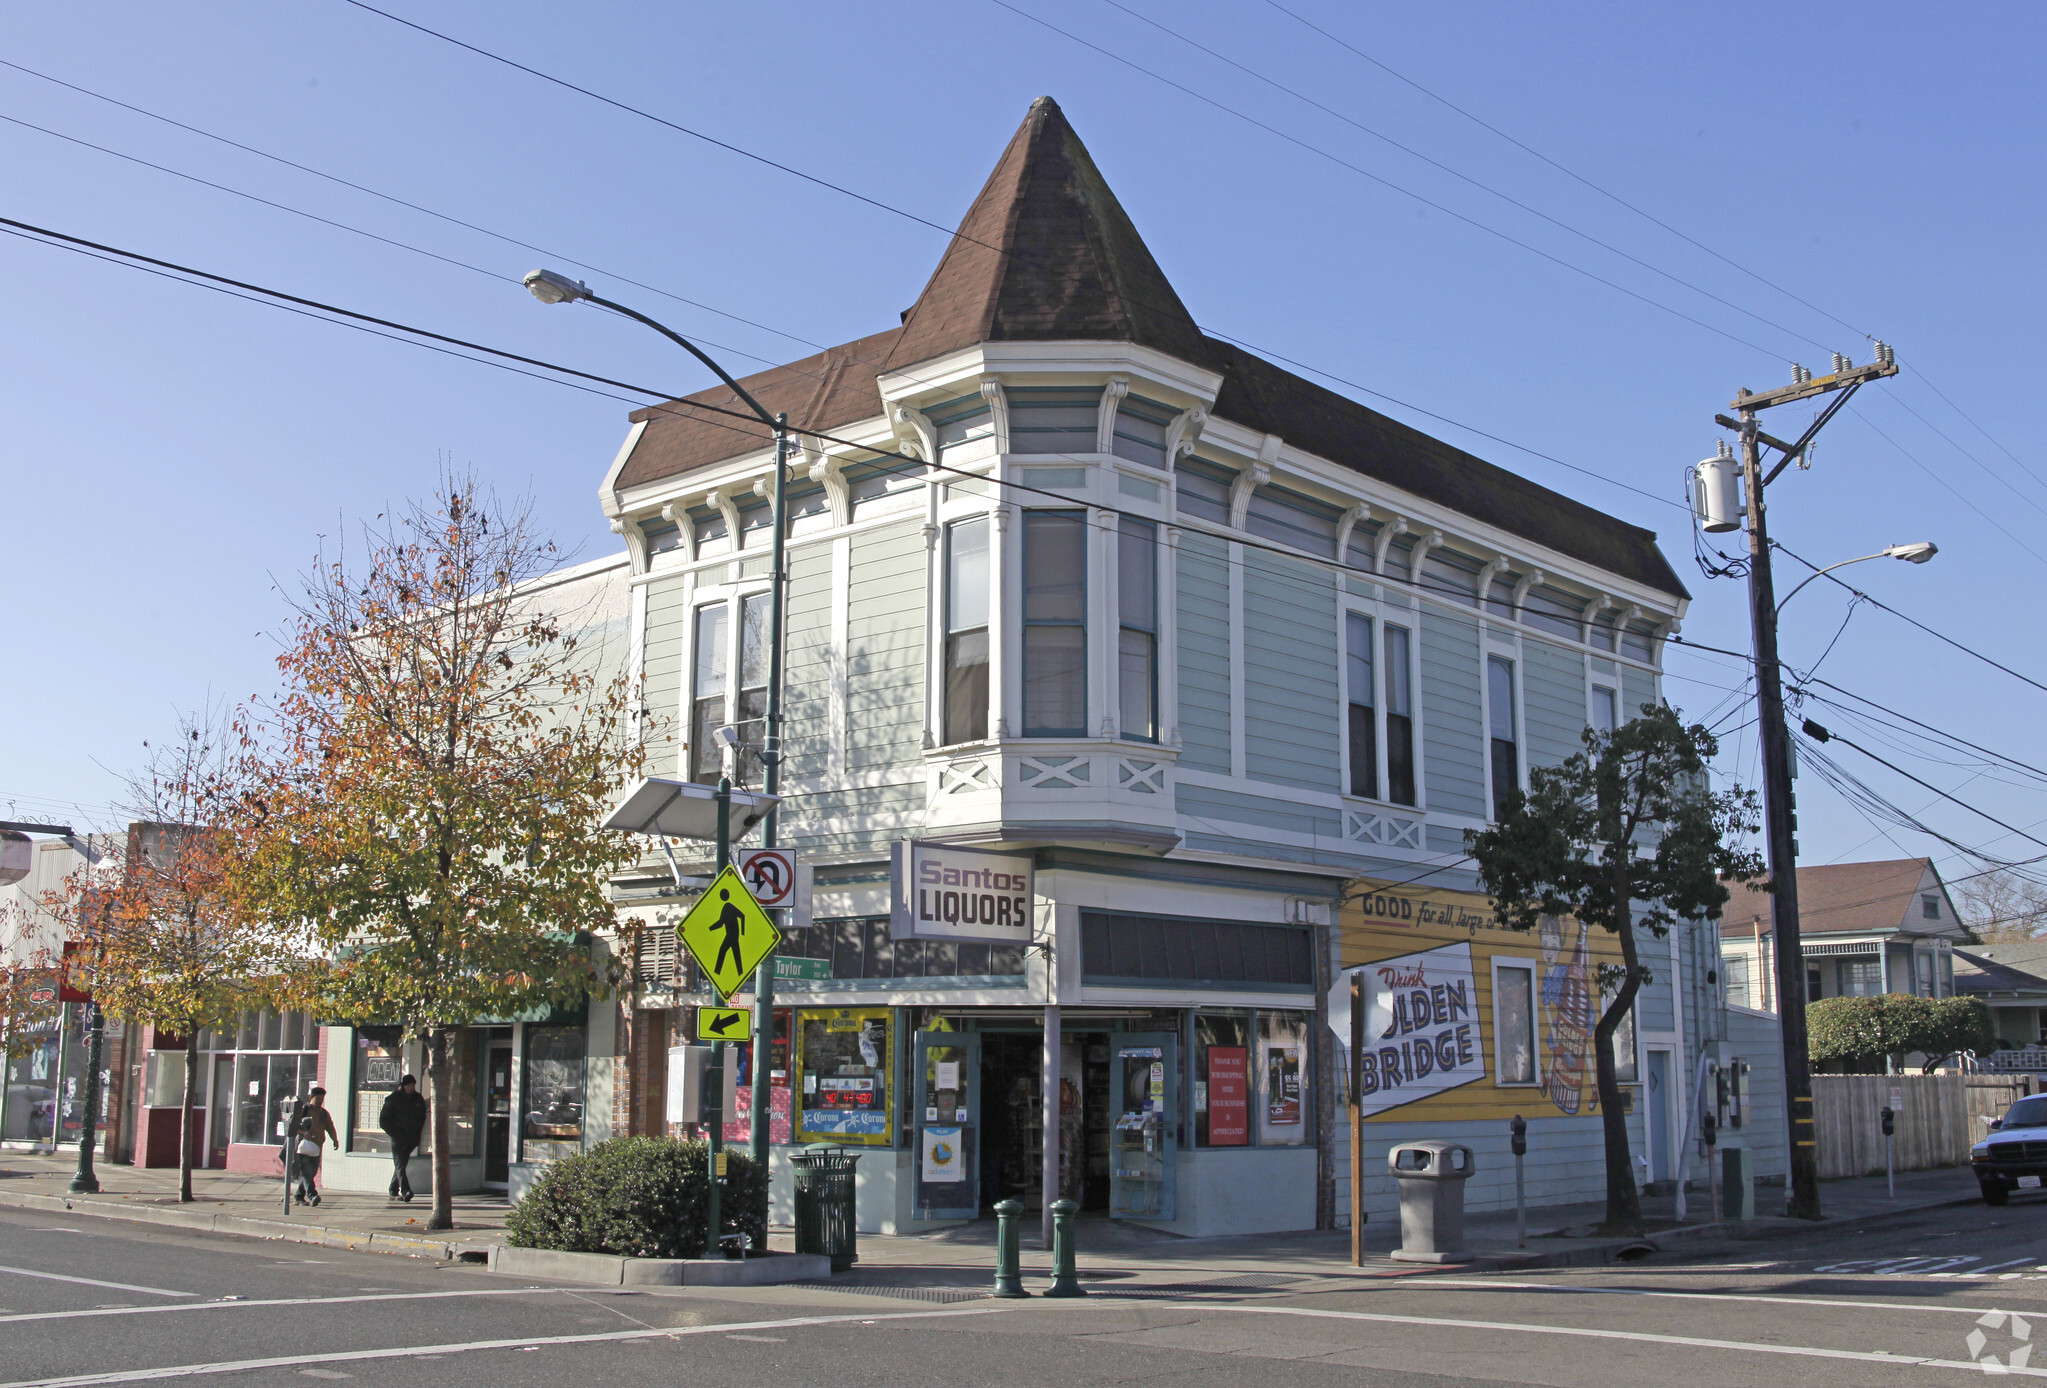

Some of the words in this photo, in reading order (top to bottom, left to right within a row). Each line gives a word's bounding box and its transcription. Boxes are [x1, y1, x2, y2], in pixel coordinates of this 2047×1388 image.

[920, 860, 1026, 892] Santos
[920, 889, 1026, 927] LIQUORS
[1363, 893, 1412, 919] GOOD
[1416, 901, 1437, 928] for
[1437, 904, 1454, 928] all,
[1457, 906, 1483, 936] large
[775, 960, 802, 977] Taylor
[1377, 960, 1429, 990] Drink
[1381, 979, 1469, 1040] OLDEN
[832, 1017, 858, 1028] Corona
[1558, 1020, 1585, 1041] GOLDEN
[1557, 1032, 1584, 1057] BRIDGE
[370, 1062, 400, 1080] OPEN
[1214, 1057, 1231, 1065] THANK
[1362, 1023, 1475, 1097] BRIDGE
[813, 1112, 839, 1125] Corona
